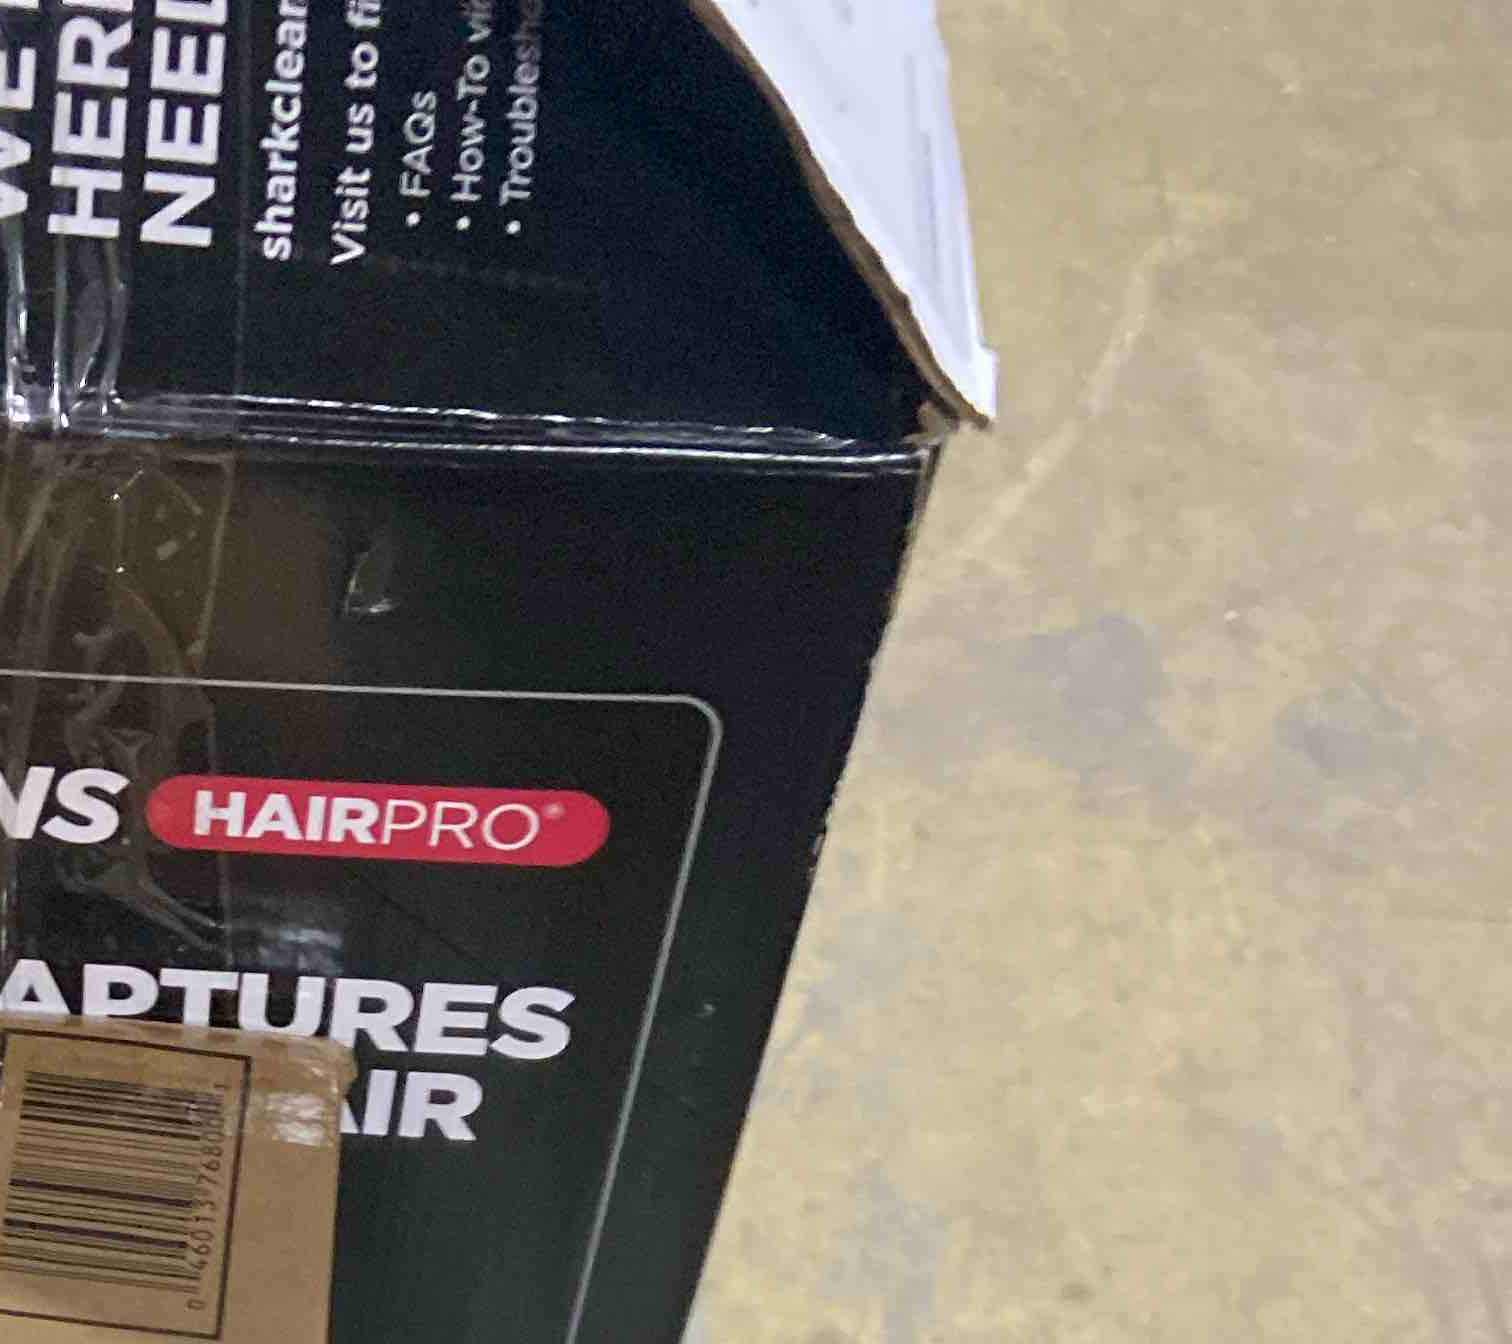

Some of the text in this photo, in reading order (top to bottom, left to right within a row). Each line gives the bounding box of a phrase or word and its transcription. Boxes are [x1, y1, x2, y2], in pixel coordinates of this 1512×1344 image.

[344, 40, 379, 90] to
[345, 102, 377, 155] us
[398, 90, 438, 198] FAQs
[449, 53, 492, 202] How-To
[329, 165, 373, 267] Visit
